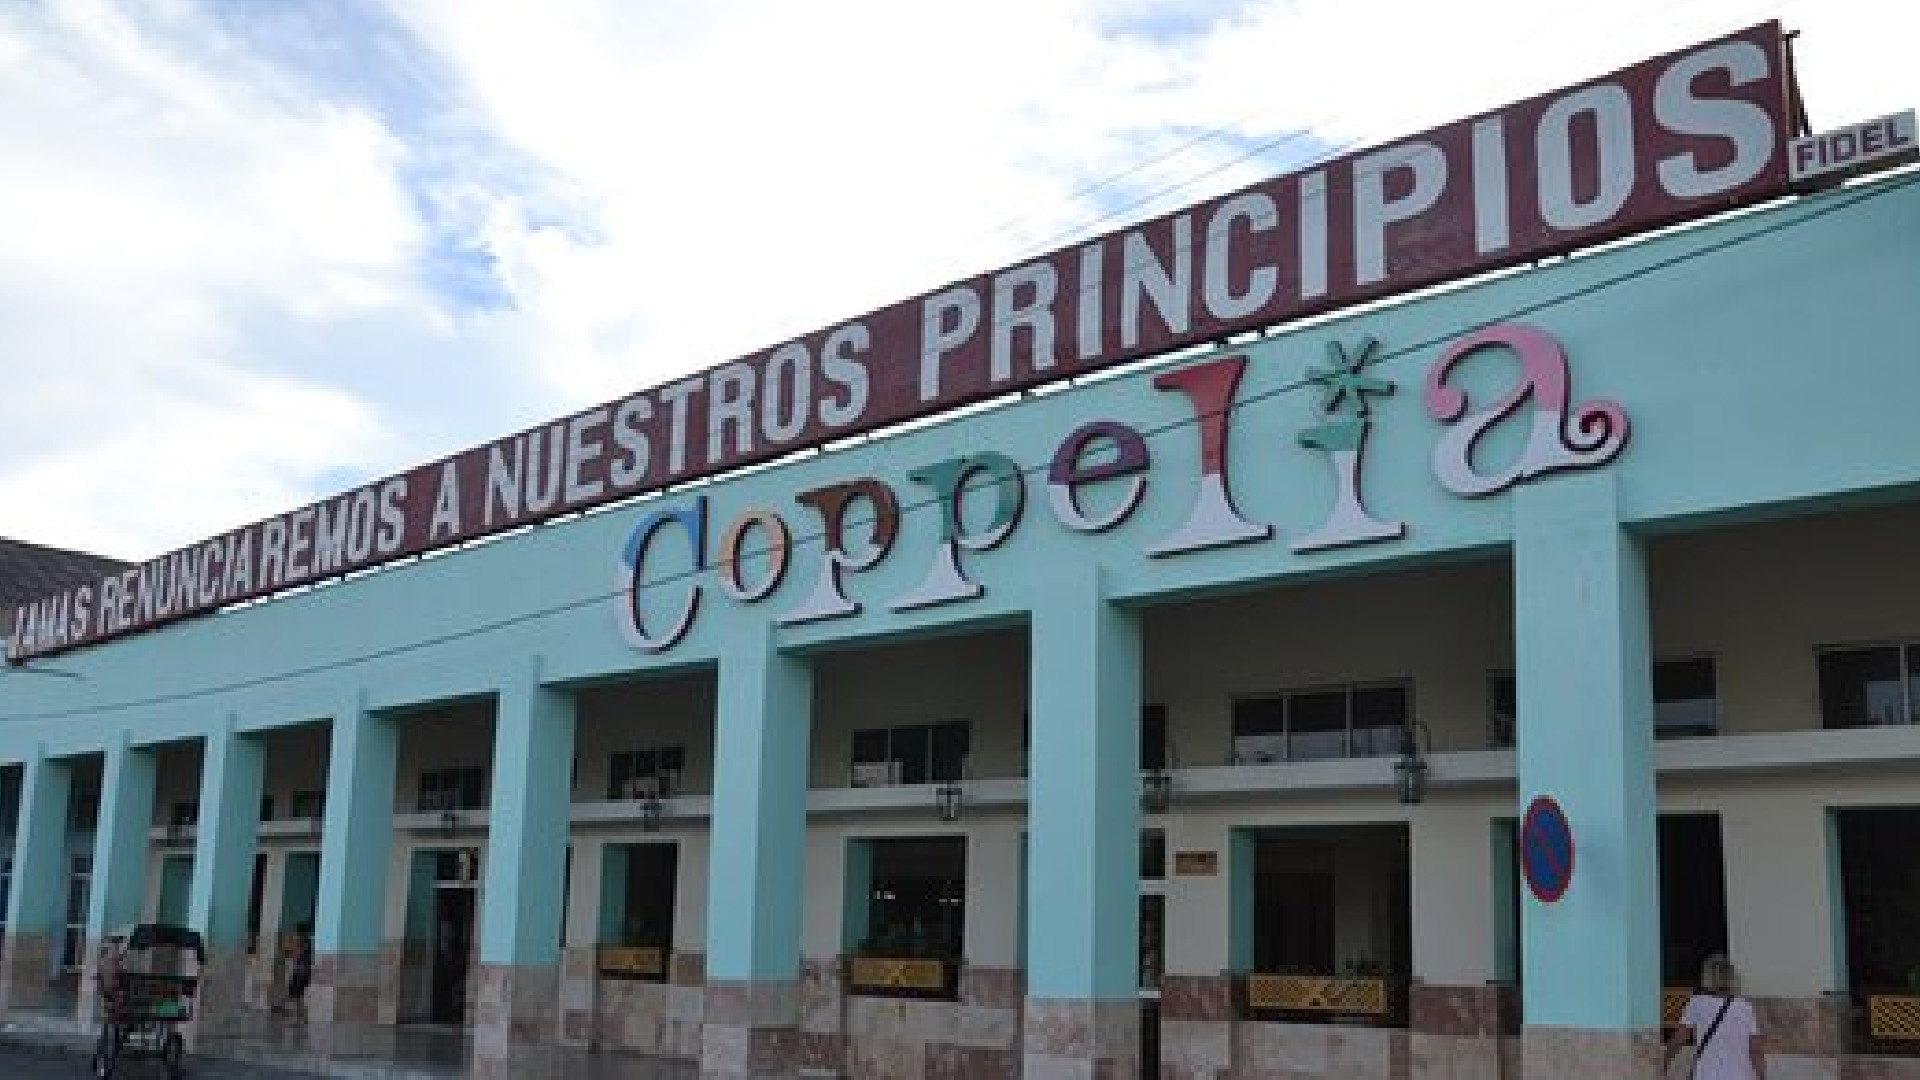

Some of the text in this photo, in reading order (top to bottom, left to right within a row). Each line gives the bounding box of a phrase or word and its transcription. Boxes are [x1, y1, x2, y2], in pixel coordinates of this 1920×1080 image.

[429, 462, 460, 539] A
[484, 323, 870, 526] NUESTROS
[918, 40, 1775, 402] PRINCIPIOS
[1796, 119, 1910, 173] FIDEL
[614, 322, 1631, 654] Coppelia
